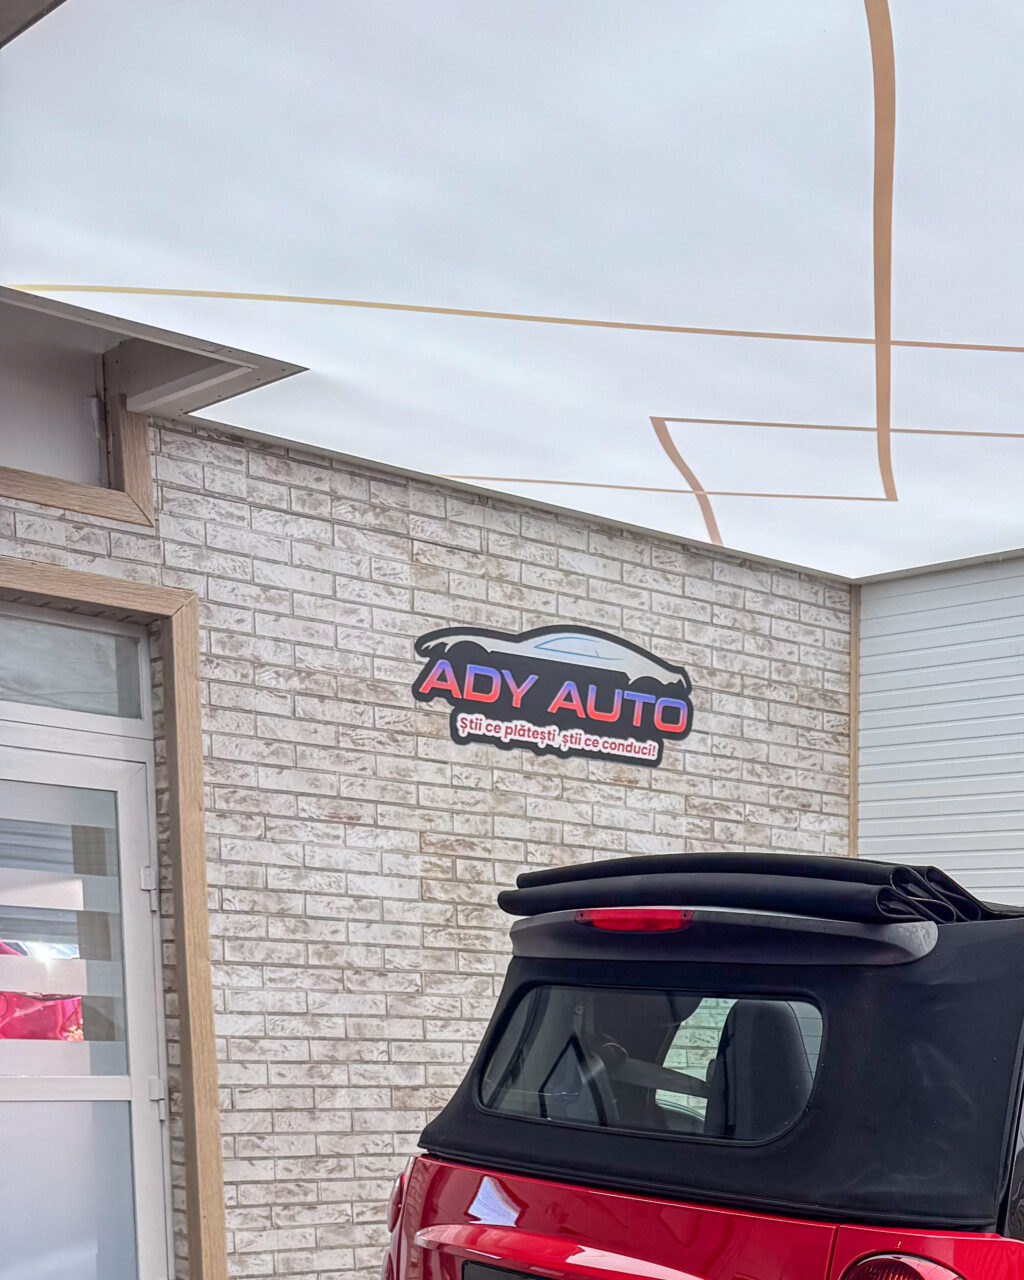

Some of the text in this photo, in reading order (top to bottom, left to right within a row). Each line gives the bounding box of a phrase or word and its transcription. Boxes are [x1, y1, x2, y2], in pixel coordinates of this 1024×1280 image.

[419, 659, 688, 735] ADY AUTO
[460, 716, 483, 734] Știi
[485, 723, 501, 734] ce
[561, 732, 582, 748] știi
[584, 737, 600, 748] ce
[601, 741, 656, 757] conduci!
